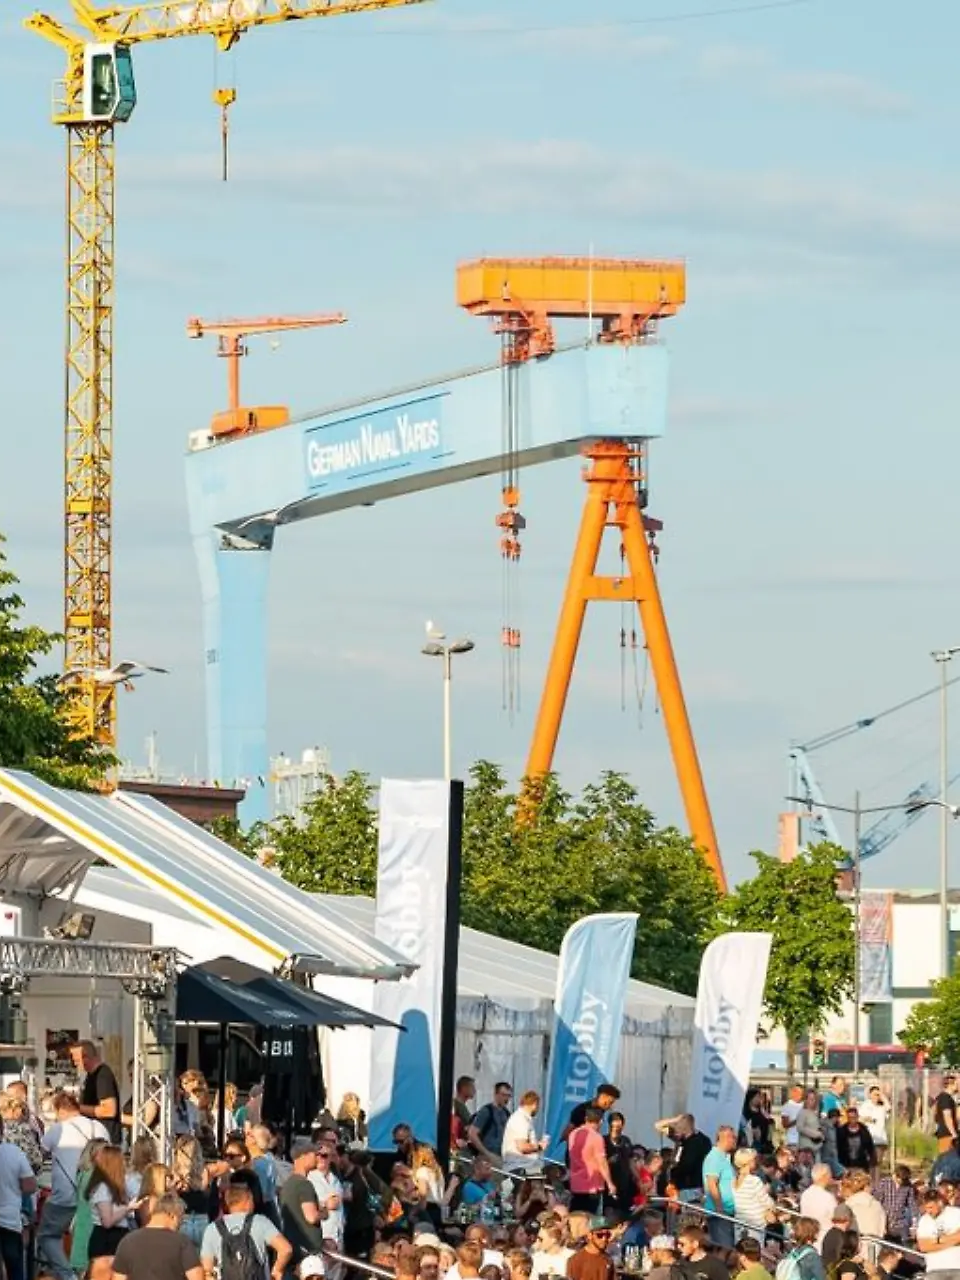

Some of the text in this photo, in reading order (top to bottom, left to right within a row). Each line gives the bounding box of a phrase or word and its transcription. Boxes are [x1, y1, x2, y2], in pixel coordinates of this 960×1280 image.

[308, 413, 439, 477] GERMAN NAVAL YARDS
[564, 988, 608, 1102] Hobby
[702, 995, 741, 1102] Hobby
